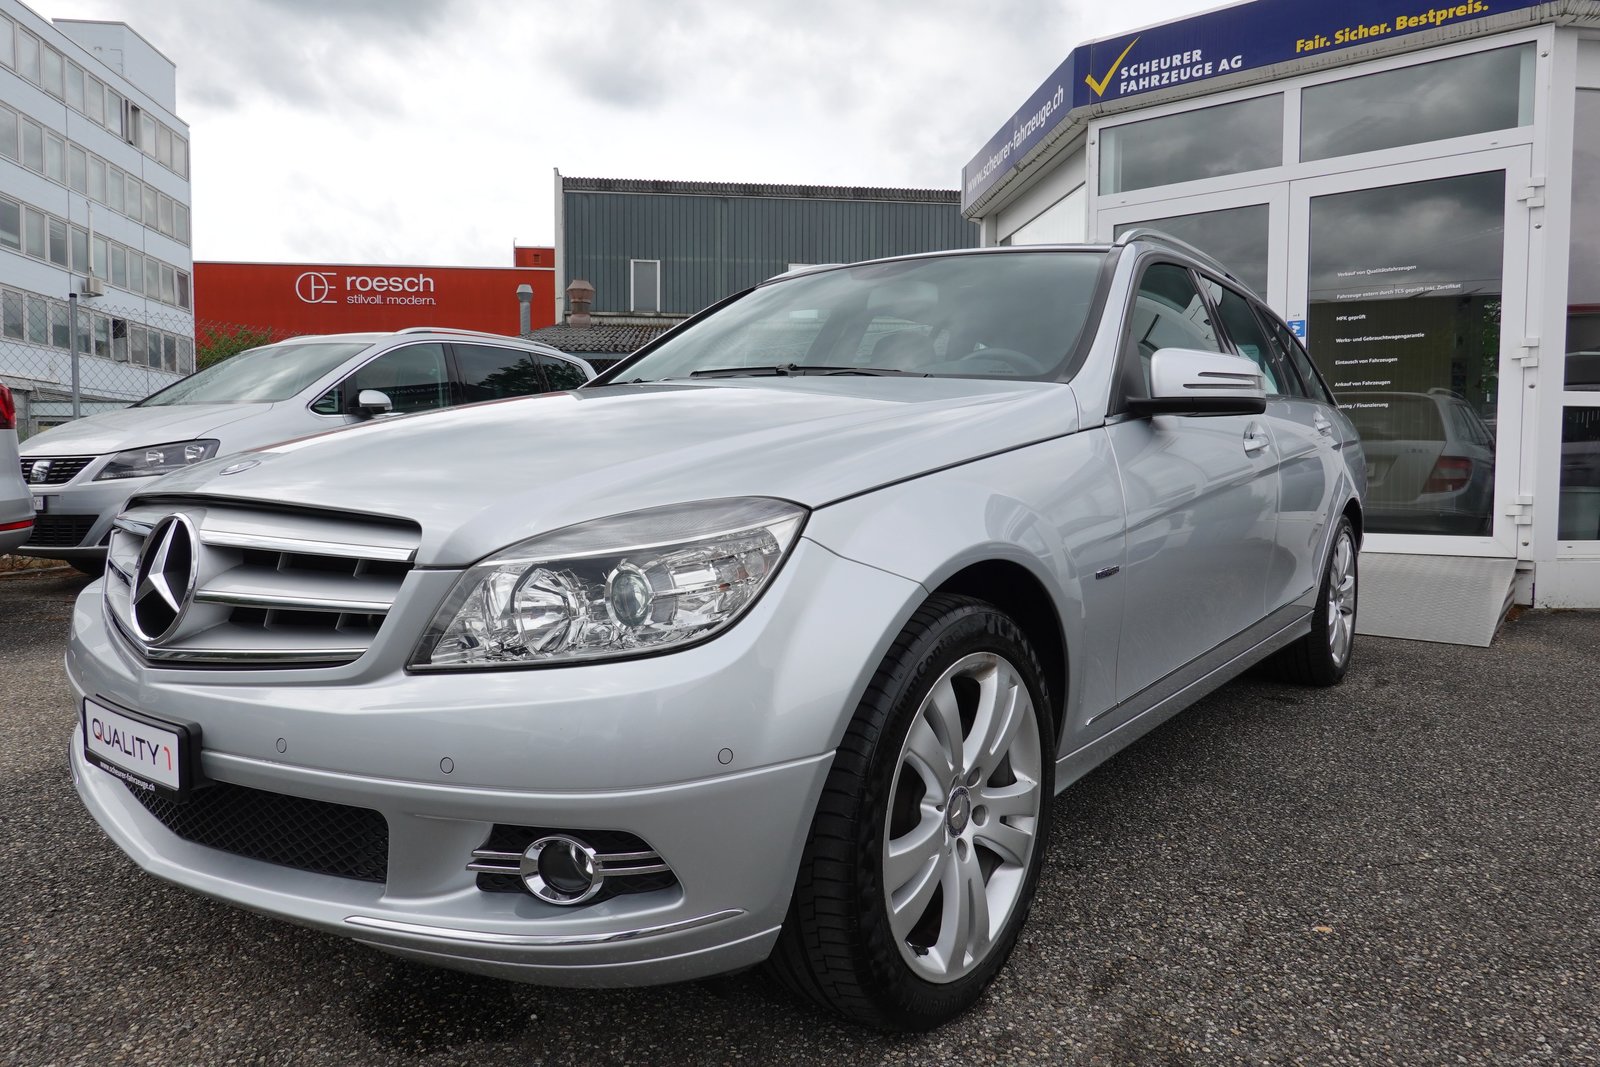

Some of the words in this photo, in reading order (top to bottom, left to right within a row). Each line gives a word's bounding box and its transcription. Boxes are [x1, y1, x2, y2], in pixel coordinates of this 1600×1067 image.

[1295, 35, 1331, 53] Fair.
[1334, 22, 1391, 45] Sicher.
[1395, 0, 1489, 31] Bestpreis.
[1119, 62, 1213, 95] FAHRZEUGE
[1217, 54, 1243, 73] AG
[1120, 49, 1202, 80] SCHEURER
[967, 84, 1064, 194] www.scheurer-fahrzeuge.ch
[346, 273, 434, 293] roesch
[1337, 270, 1356, 278] Verkauf
[346, 294, 383, 305] stilvoll.
[386, 294, 436, 305] modern.
[1363, 332, 1425, 341] Gebrauchtwagengarantie
